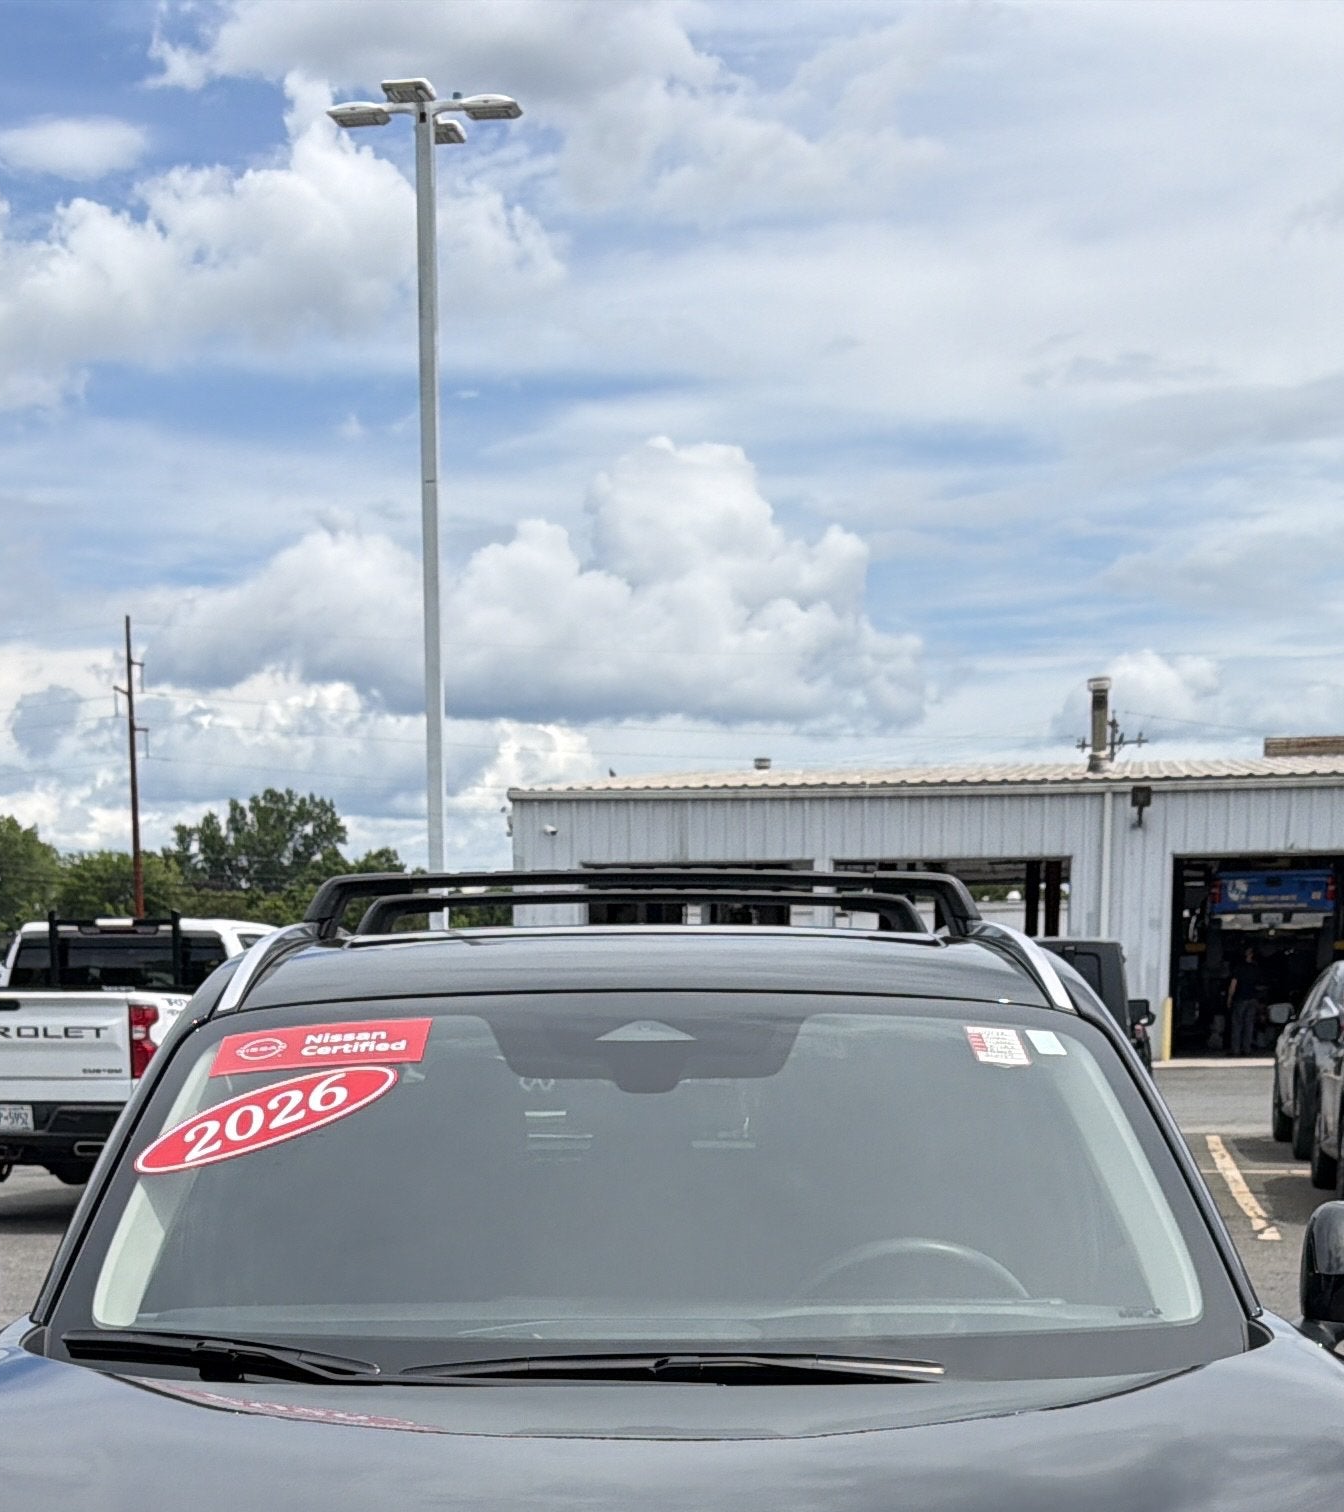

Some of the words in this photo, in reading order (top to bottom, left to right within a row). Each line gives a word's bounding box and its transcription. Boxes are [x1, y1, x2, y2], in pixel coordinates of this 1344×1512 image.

[304, 1030, 387, 1046] Nissan
[300, 1040, 407, 1057] Certified
[183, 1072, 349, 1163] 2026
